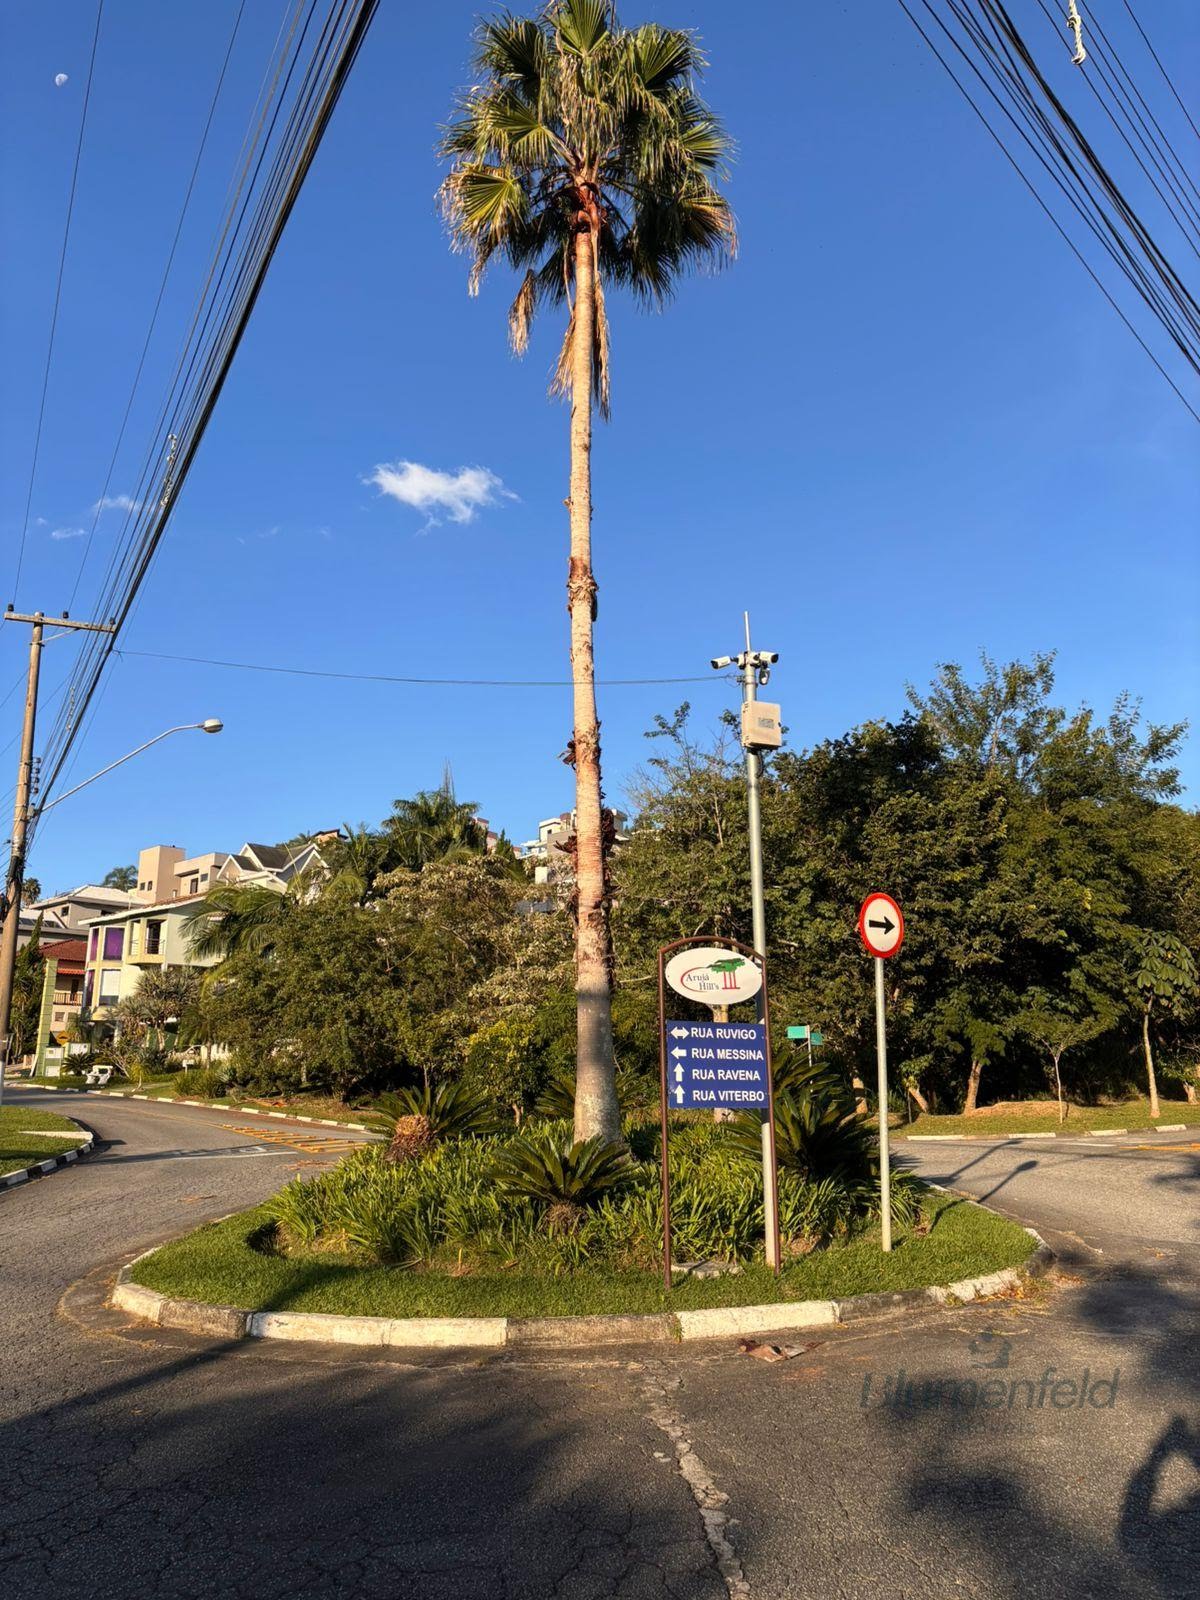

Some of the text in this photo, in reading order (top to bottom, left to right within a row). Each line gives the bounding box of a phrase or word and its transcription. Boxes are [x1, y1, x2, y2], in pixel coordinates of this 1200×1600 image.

[691, 1027, 757, 1040] RUA RUVIGO
[691, 1048, 764, 1061] RUA MESSINA
[692, 1069, 761, 1081] RUA RAVENA
[693, 1090, 765, 1102] RUA VITERBO
